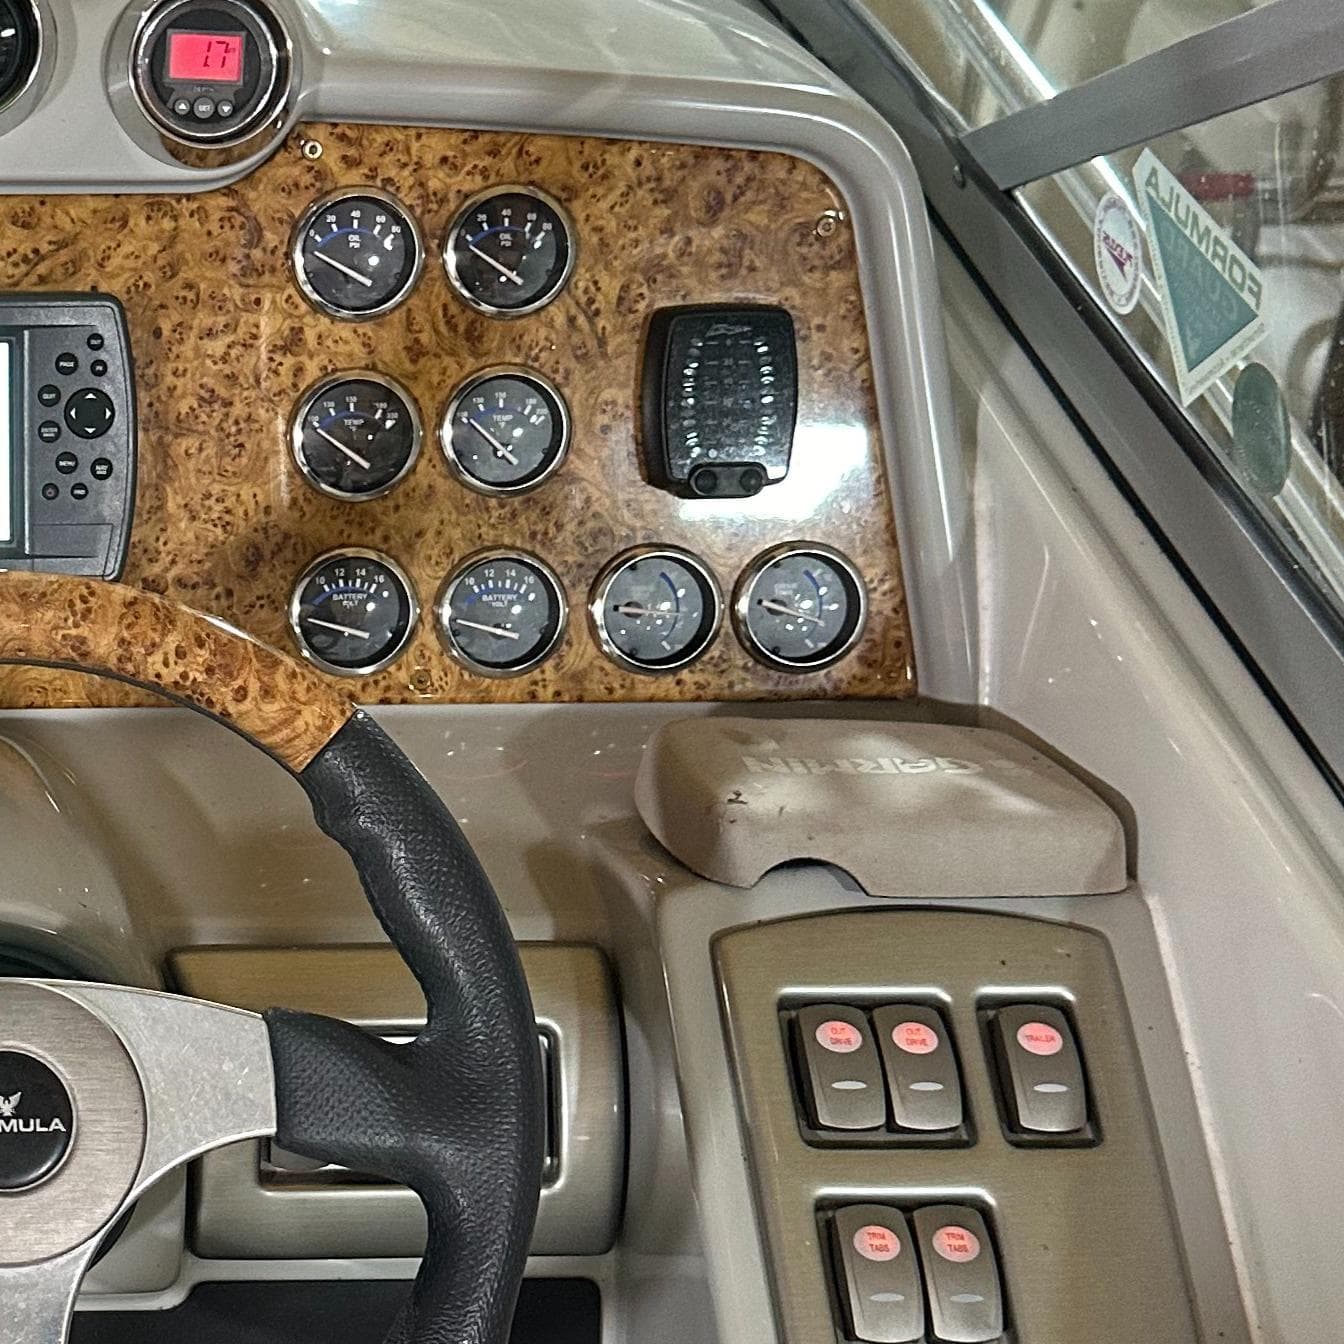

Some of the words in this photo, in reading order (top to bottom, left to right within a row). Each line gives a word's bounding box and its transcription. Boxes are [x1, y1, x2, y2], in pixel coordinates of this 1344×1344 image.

[350, 210, 361, 218] 40
[326, 215, 336, 223] 20
[335, 568, 345, 576] 12
[356, 568, 366, 576] 14
[484, 569, 495, 577] 12
[506, 569, 516, 577] 14
[316, 576, 326, 584] 10
[374, 574, 385, 583] 16
[465, 577, 475, 586] 10
[524, 576, 535, 584] 16
[332, 593, 368, 601] BATTERY
[482, 594, 518, 602] BATTERY
[868, 1243, 891, 1253] TABS
[947, 1244, 969, 1253] TABS
